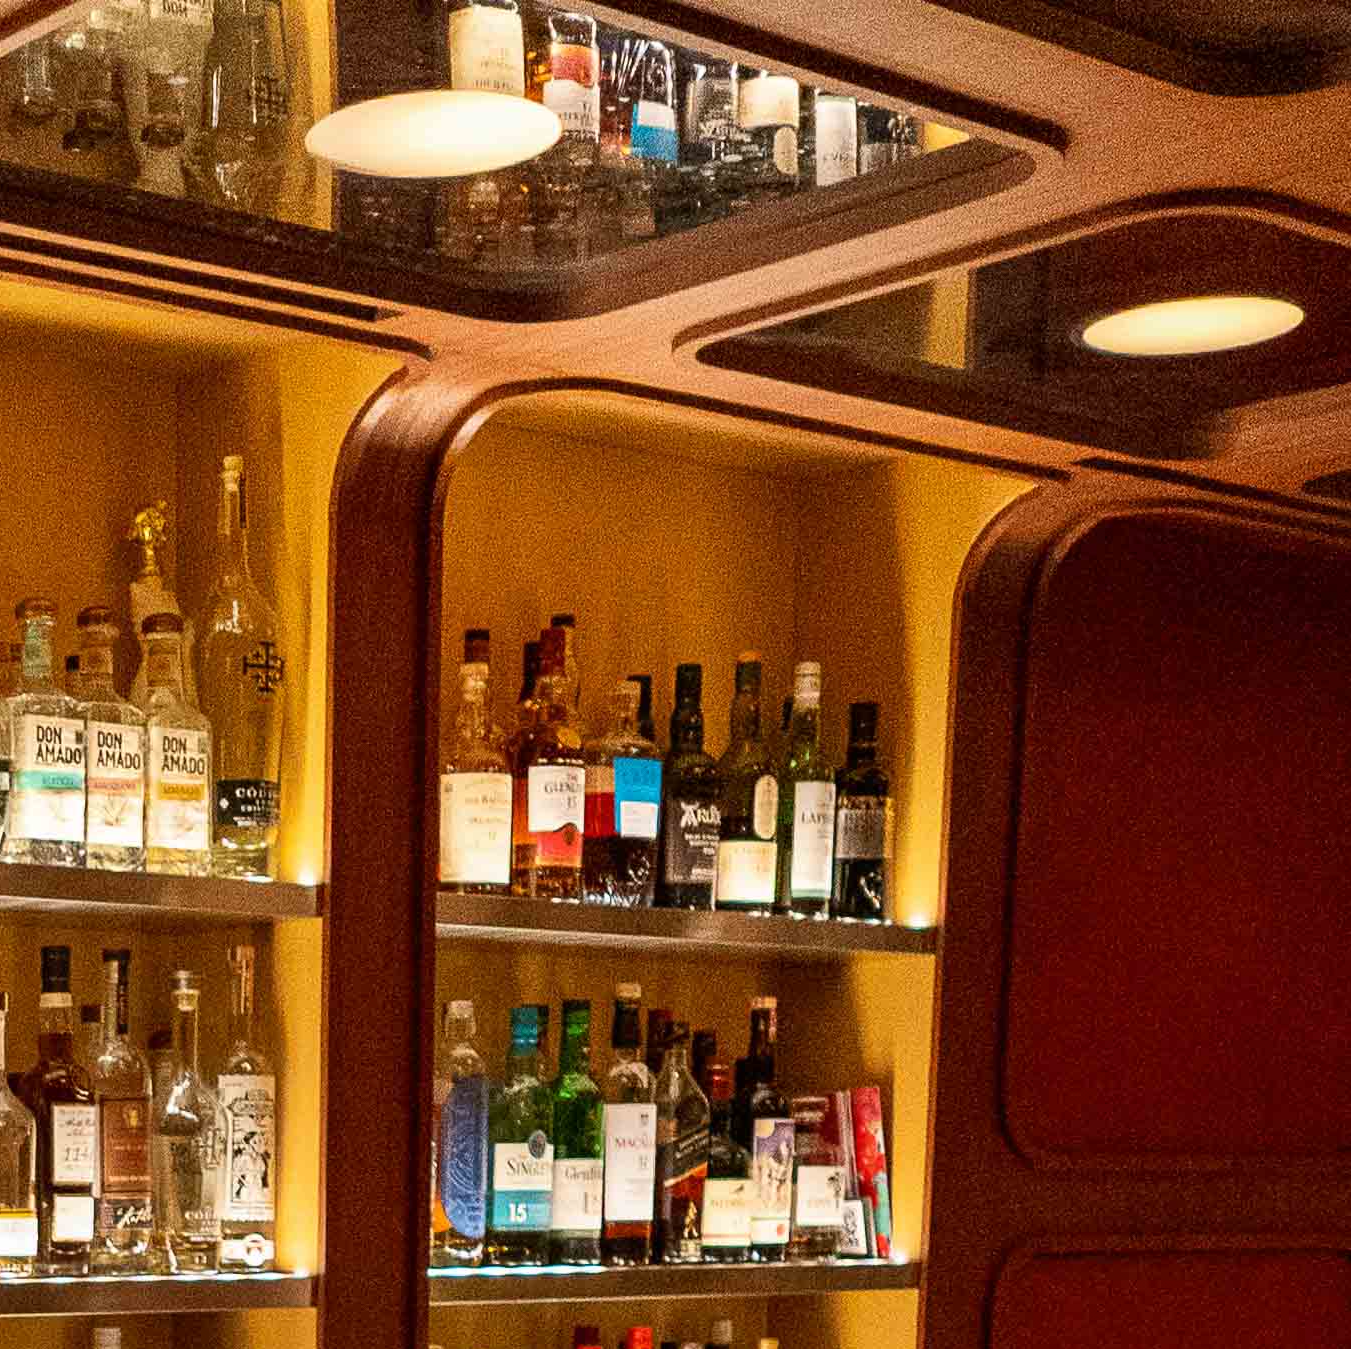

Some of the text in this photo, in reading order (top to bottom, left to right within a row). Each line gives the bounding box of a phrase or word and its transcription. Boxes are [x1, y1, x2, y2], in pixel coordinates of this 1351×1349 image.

[36, 725, 62, 744] DON
[97, 730, 122, 749] DON
[35, 744, 82, 764] AMADO
[162, 735, 187, 754] DON
[97, 750, 141, 769] AMADO
[162, 754, 205, 775] AMADO
[509, 1203, 528, 1223] 15
